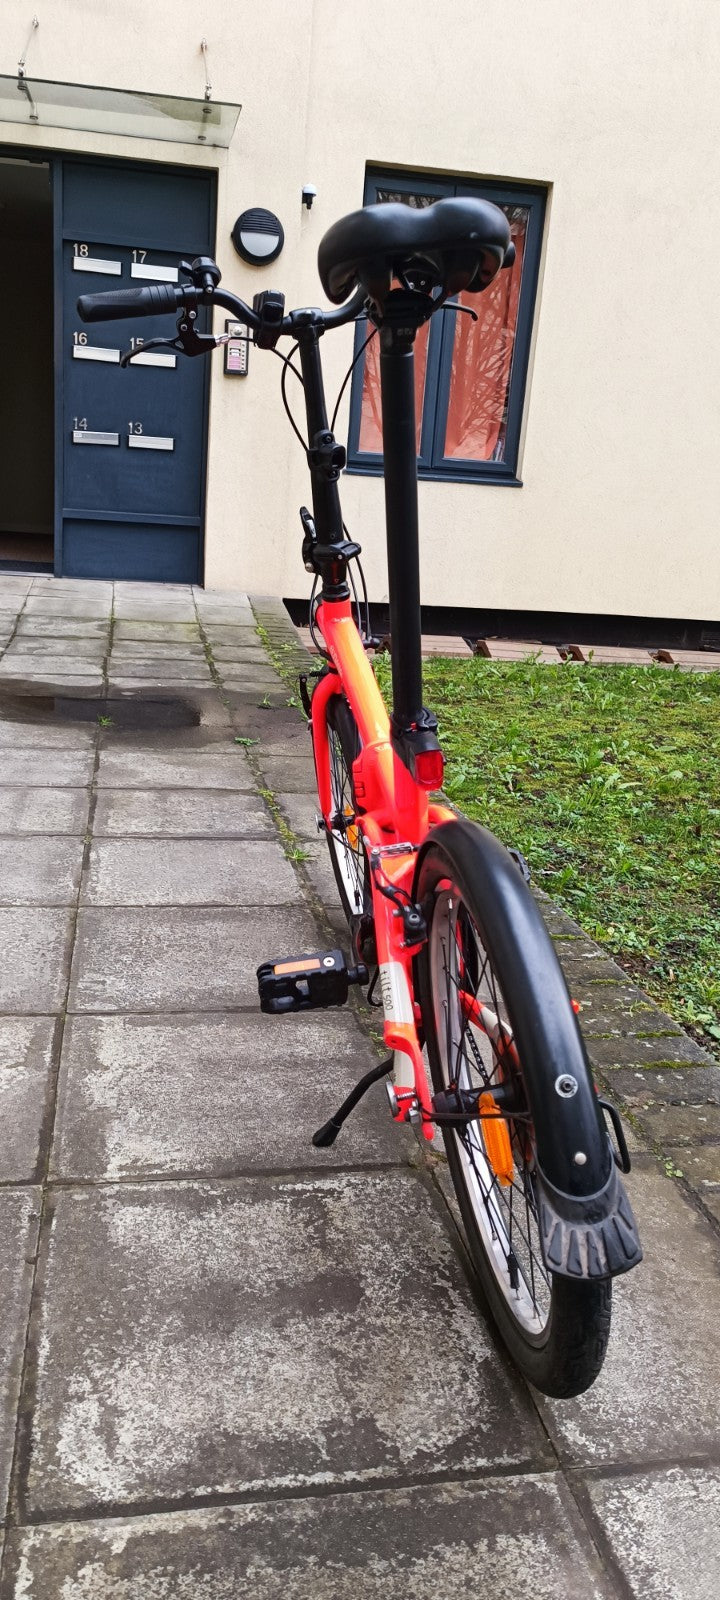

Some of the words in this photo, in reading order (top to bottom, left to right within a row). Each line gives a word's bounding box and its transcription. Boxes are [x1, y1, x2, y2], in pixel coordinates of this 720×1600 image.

[73, 243, 88, 257] 18
[132, 249, 147, 264] 17
[73, 331, 87, 345] 16
[73, 416, 87, 430] 14
[128, 422, 143, 434] 13
[380, 970, 391, 992] tilt
[385, 995, 393, 1010] 500
